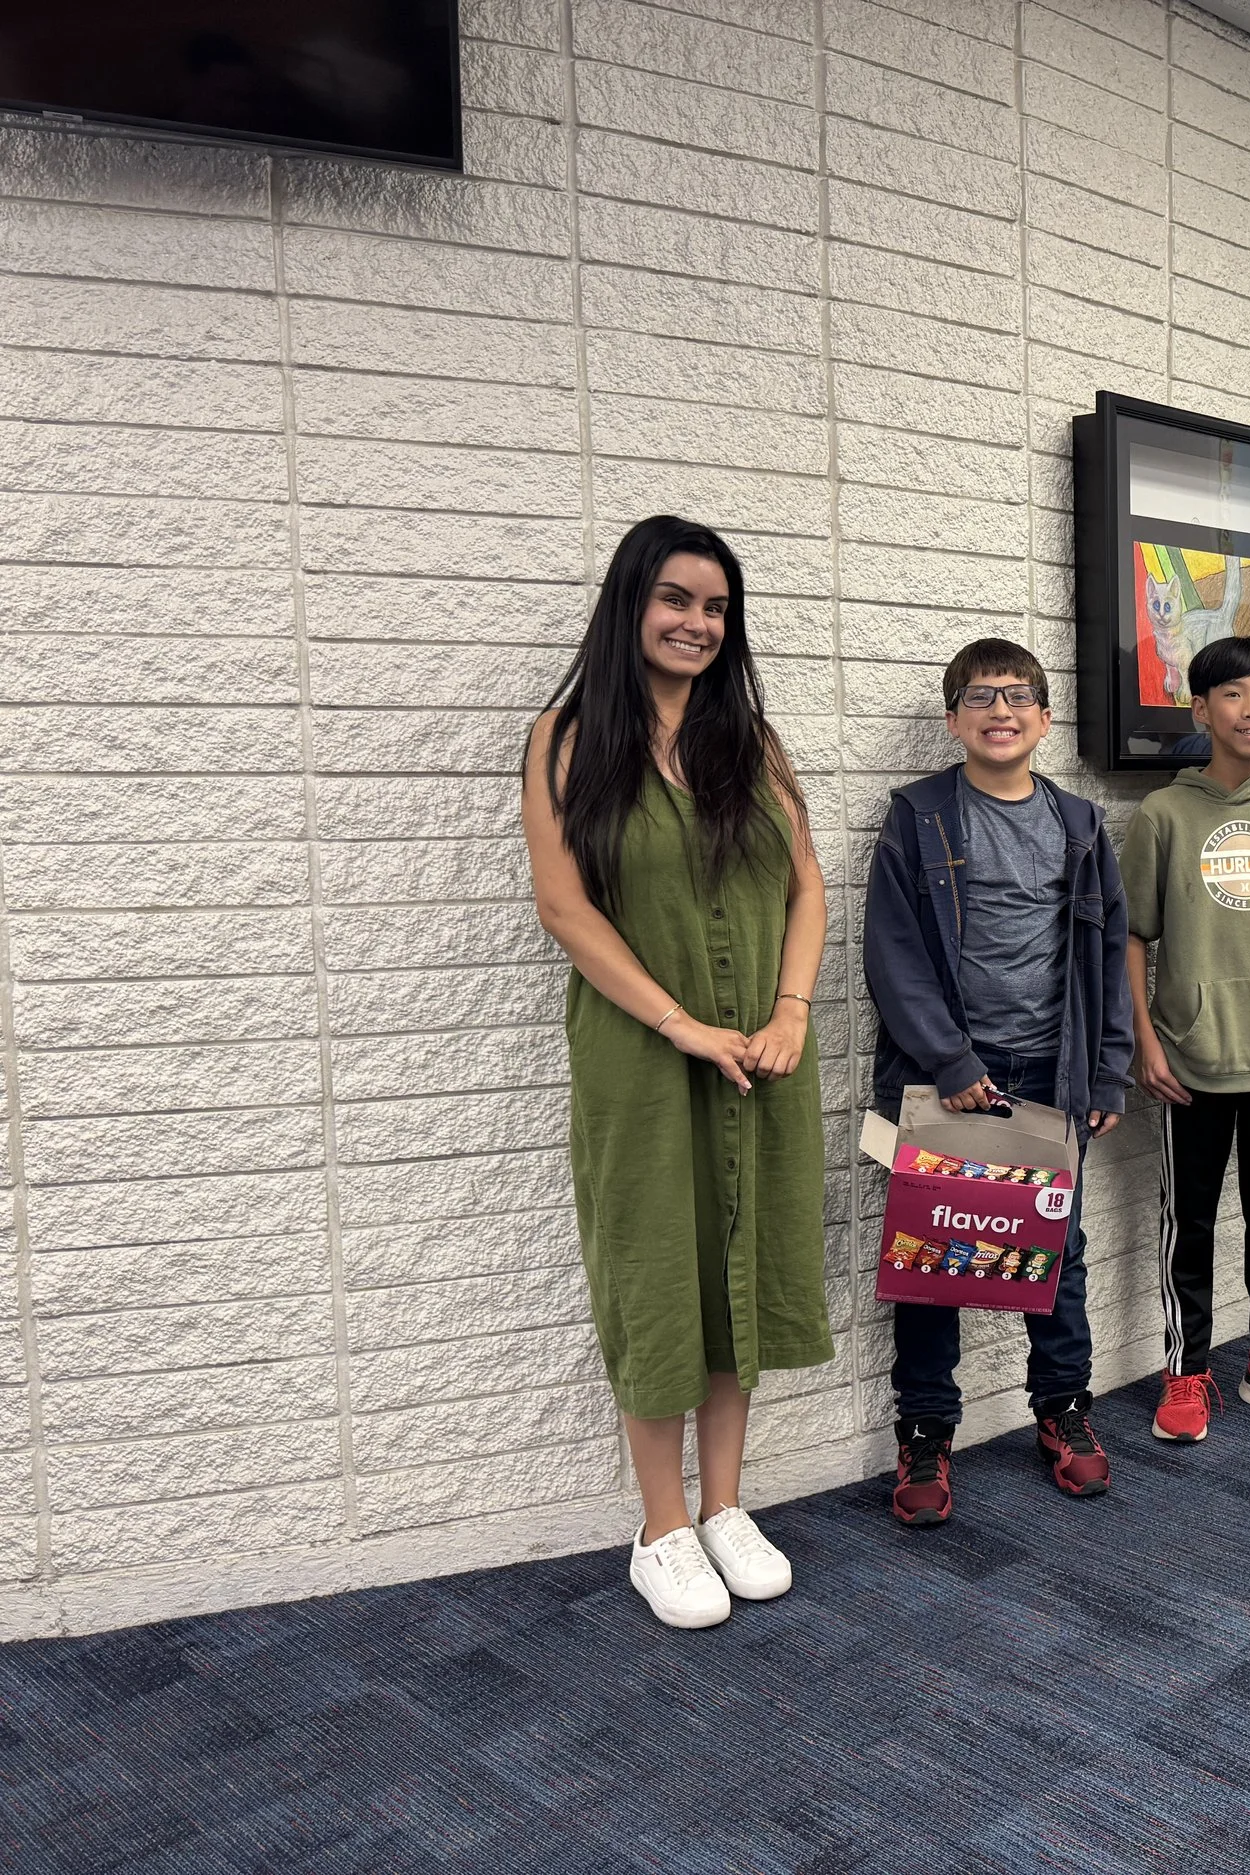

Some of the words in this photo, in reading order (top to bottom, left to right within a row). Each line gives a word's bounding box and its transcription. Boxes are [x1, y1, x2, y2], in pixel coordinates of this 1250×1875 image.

[1215, 891, 1247, 908] SINCE
[1047, 1192, 1065, 1208] 18
[931, 1204, 1025, 1235] flavor
[949, 1246, 969, 1257] Doritos
